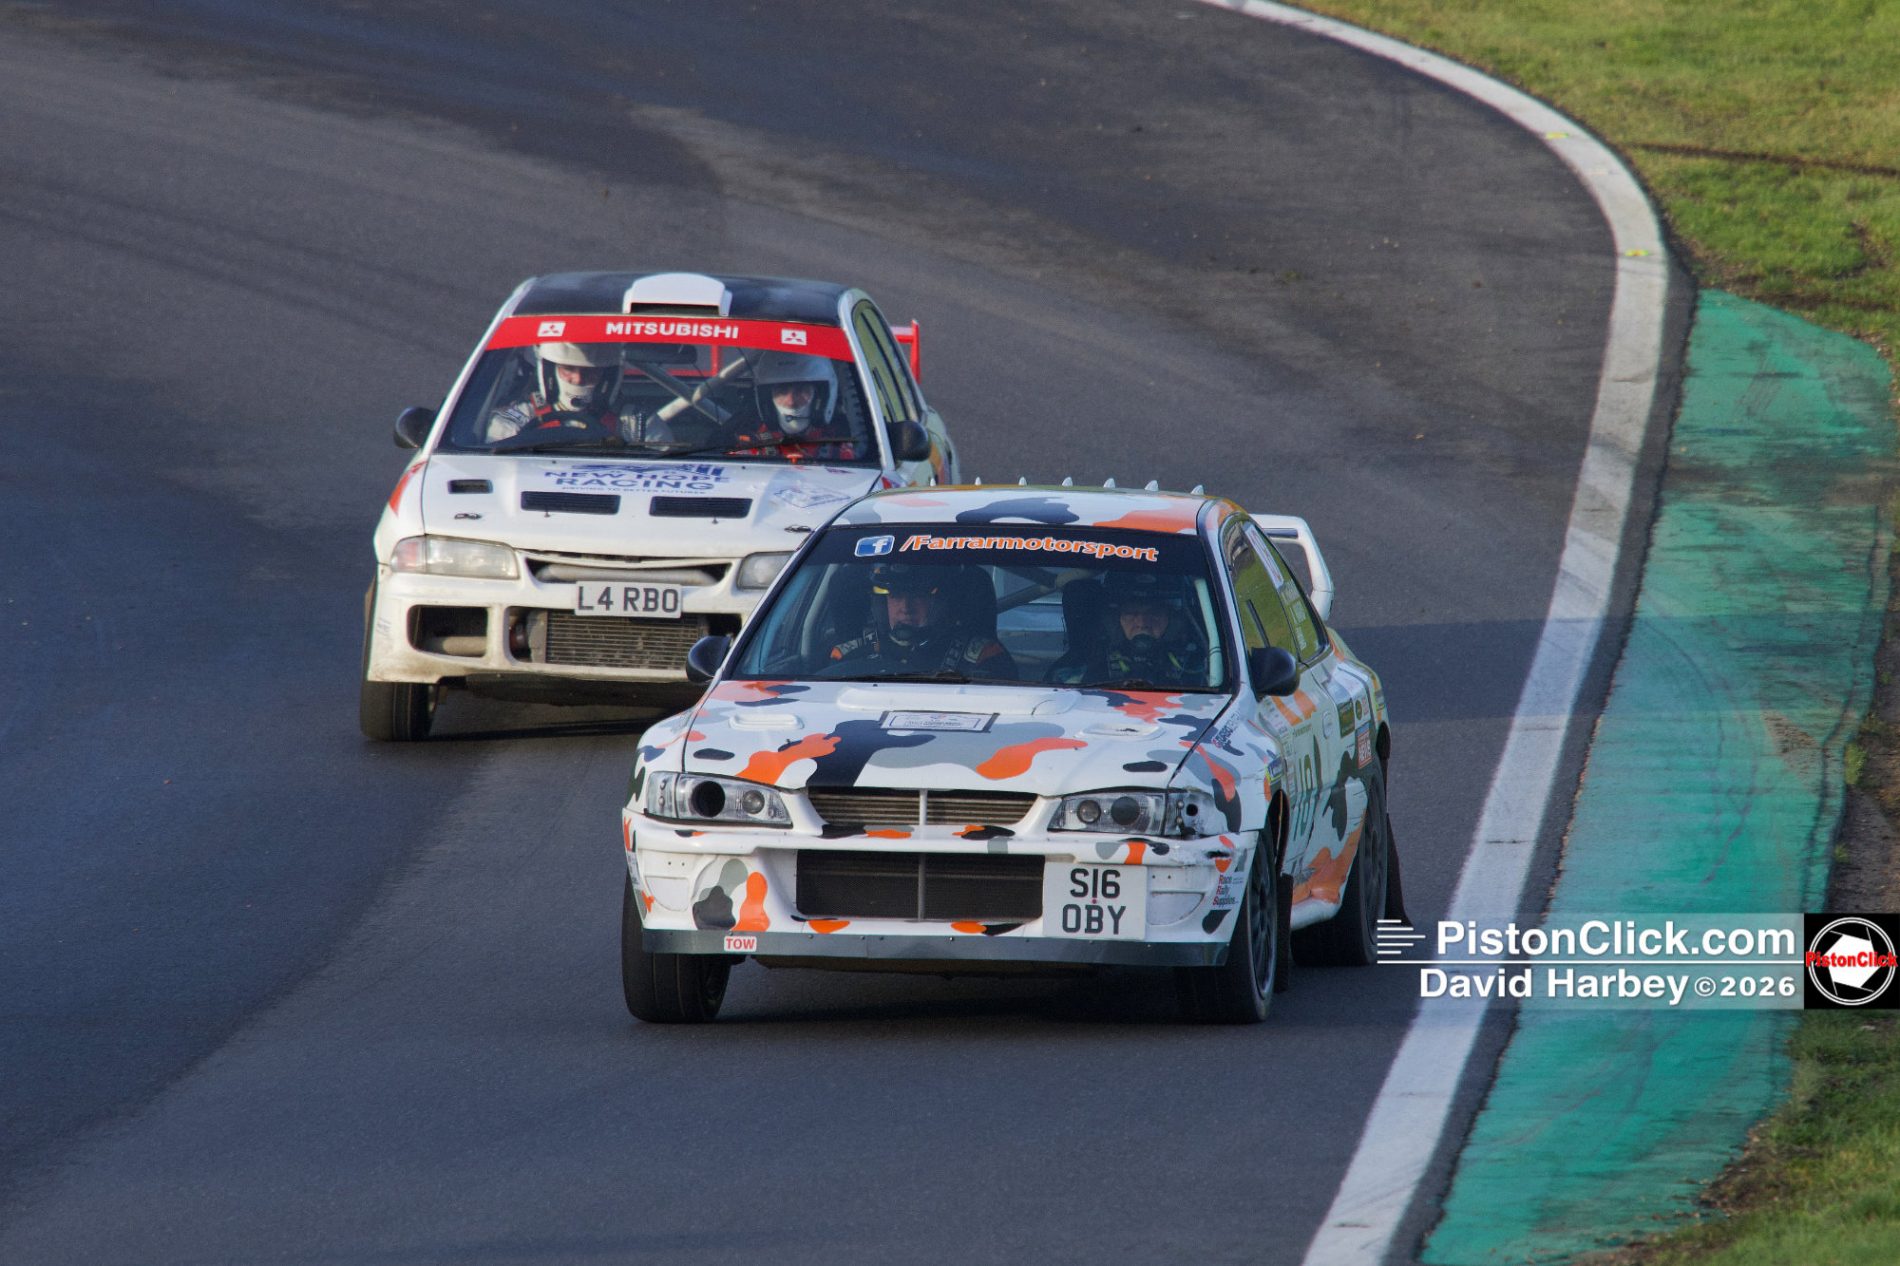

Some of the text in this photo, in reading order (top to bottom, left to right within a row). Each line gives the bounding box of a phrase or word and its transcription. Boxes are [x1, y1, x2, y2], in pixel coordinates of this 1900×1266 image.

[606, 322, 739, 339] MITSUBISHI
[555, 478, 715, 490] RACING
[636, 474, 731, 483] HOPE
[899, 534, 1159, 561] /Farrarmotorsport
[577, 586, 679, 612] L4 RBO
[1070, 868, 1121, 899] S16
[1062, 904, 1127, 935] OBY
[726, 938, 755, 950] TOW
